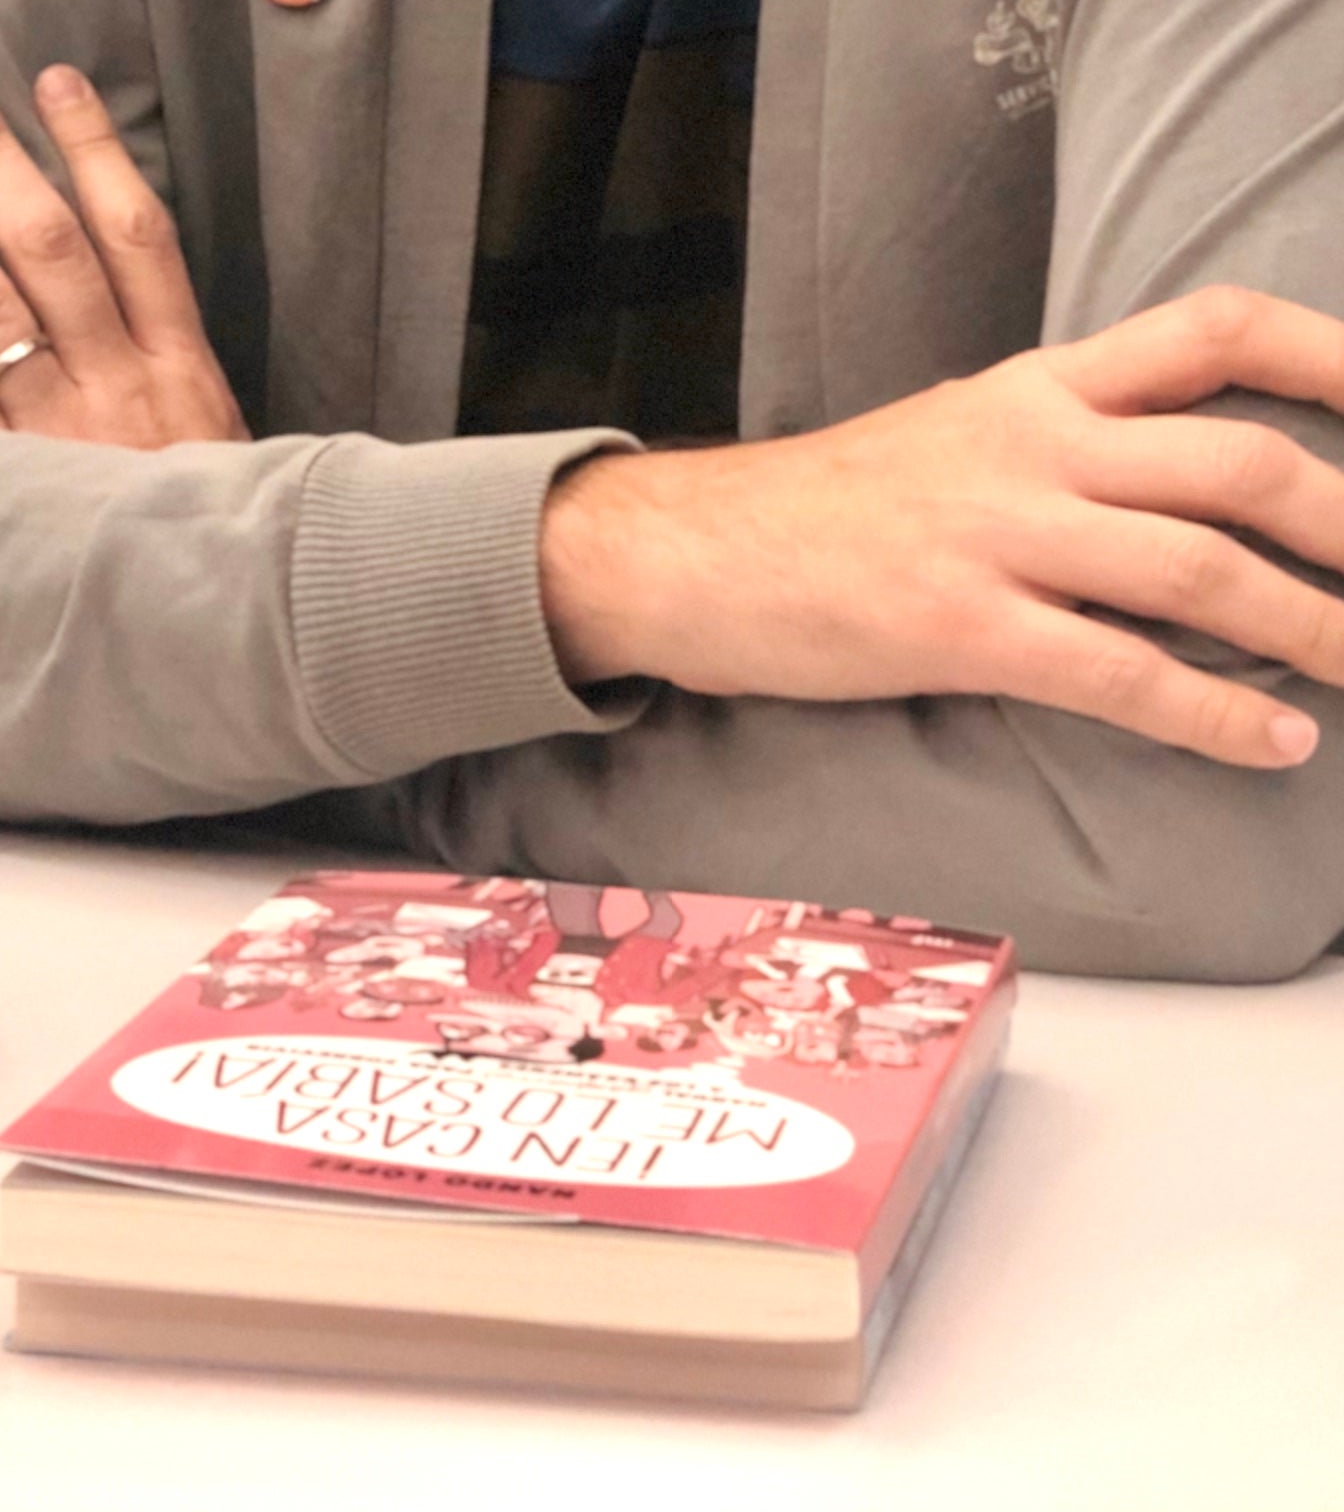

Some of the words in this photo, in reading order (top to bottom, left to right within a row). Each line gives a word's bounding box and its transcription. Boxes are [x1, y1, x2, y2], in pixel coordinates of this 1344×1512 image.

[276, 1100, 482, 1158] CASA
[500, 1088, 618, 1131] LO
[641, 1102, 788, 1151] ME
[445, 1175, 576, 1199] NANDO
